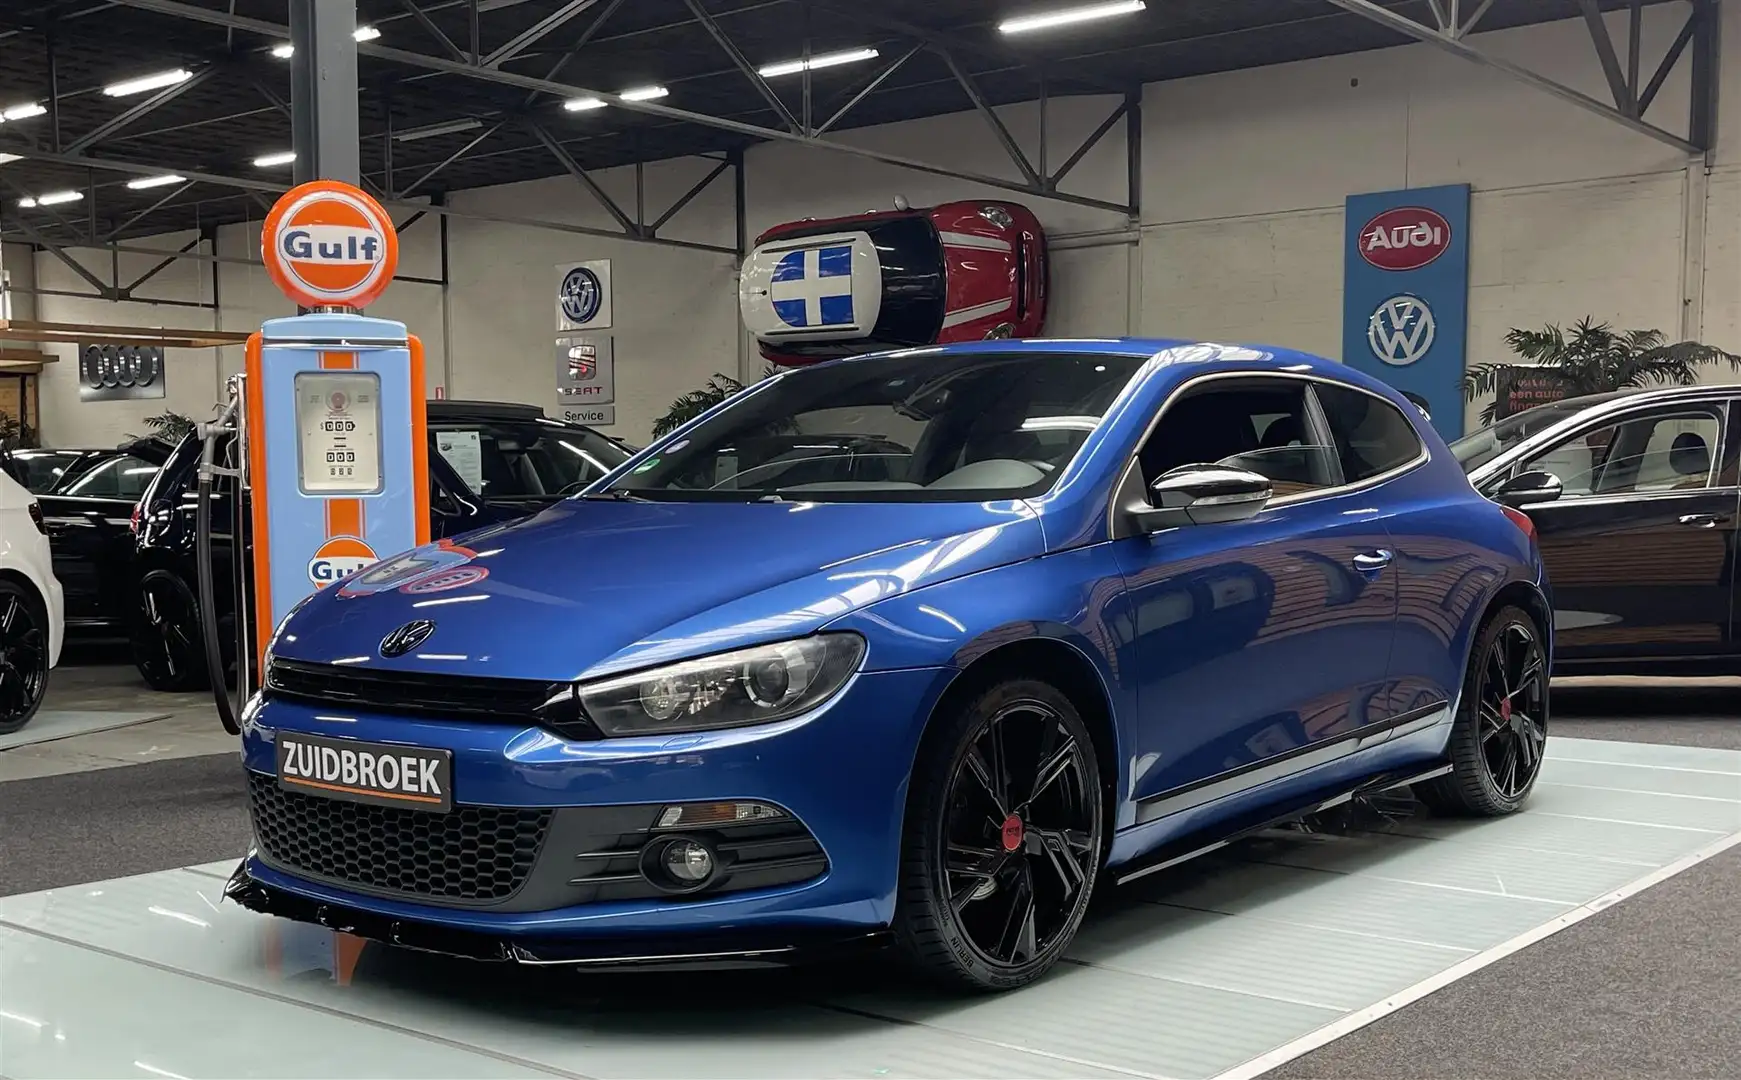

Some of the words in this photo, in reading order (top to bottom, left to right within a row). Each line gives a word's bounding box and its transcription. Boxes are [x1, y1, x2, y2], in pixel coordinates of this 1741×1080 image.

[283, 230, 378, 260] Gulf
[564, 386, 603, 396] SEAT
[564, 411, 604, 421] Service
[282, 740, 442, 795] ZUIDBROEK
